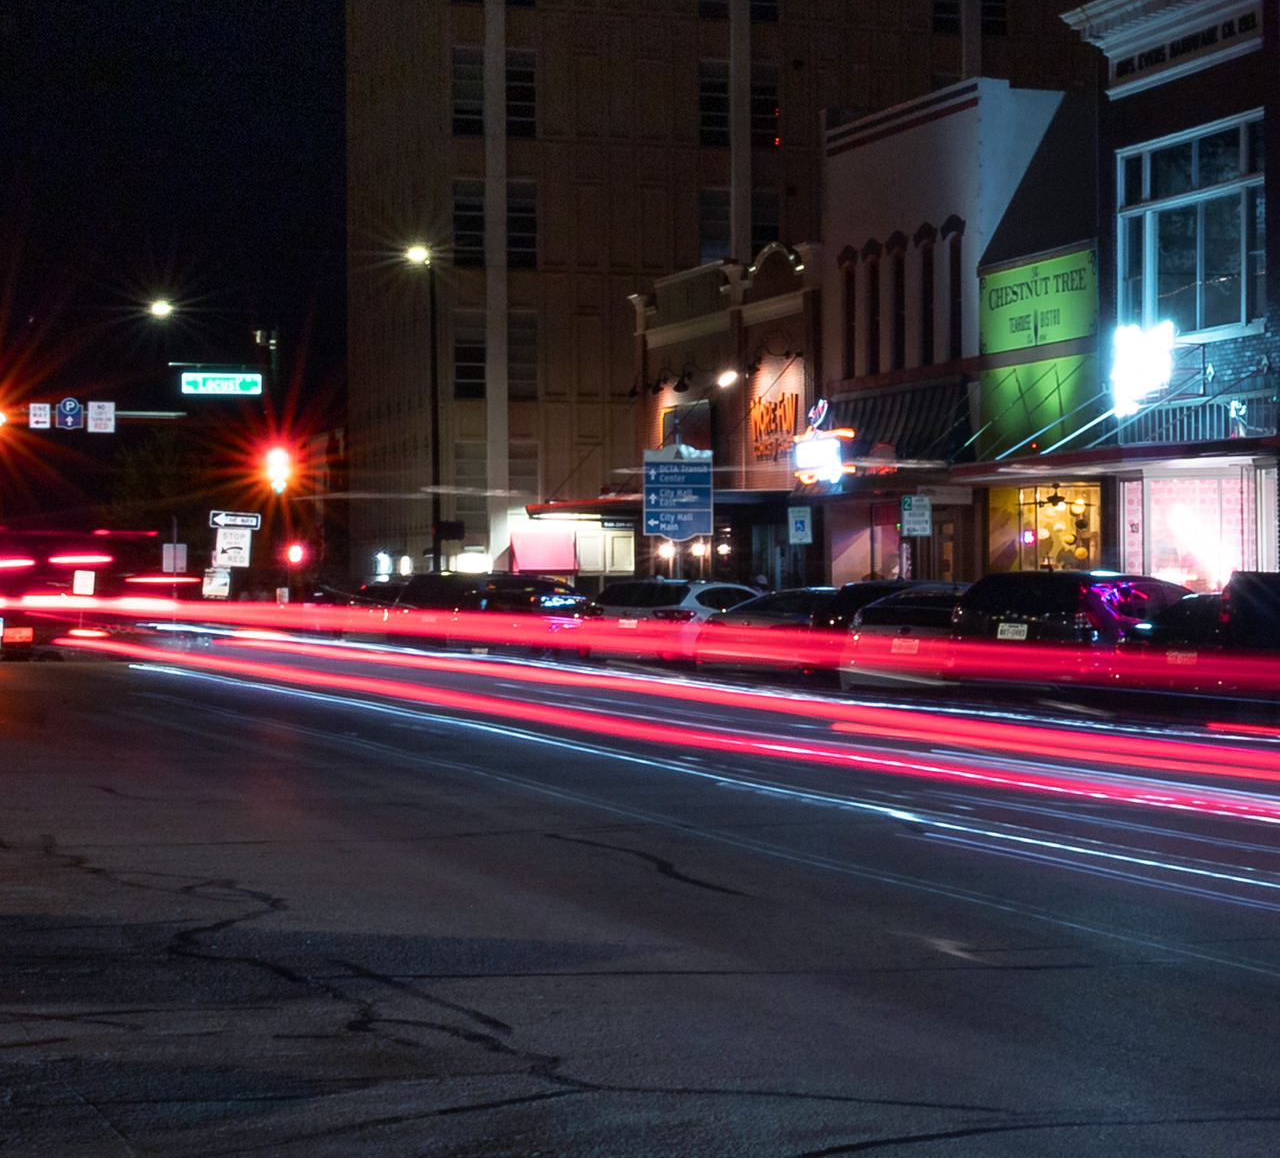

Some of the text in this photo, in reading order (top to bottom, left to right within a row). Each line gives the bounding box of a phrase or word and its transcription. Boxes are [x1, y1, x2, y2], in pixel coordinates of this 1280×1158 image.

[988, 267, 1087, 311] CHESTNUT TREE
[65, 401, 75, 411] P
[659, 474, 686, 482] Center
[659, 489, 693, 498] City Hall
[903, 497, 911, 509] 2
[659, 513, 693, 523] City Hall
[660, 523, 679, 531] Main
[222, 532, 246, 540] STOP
